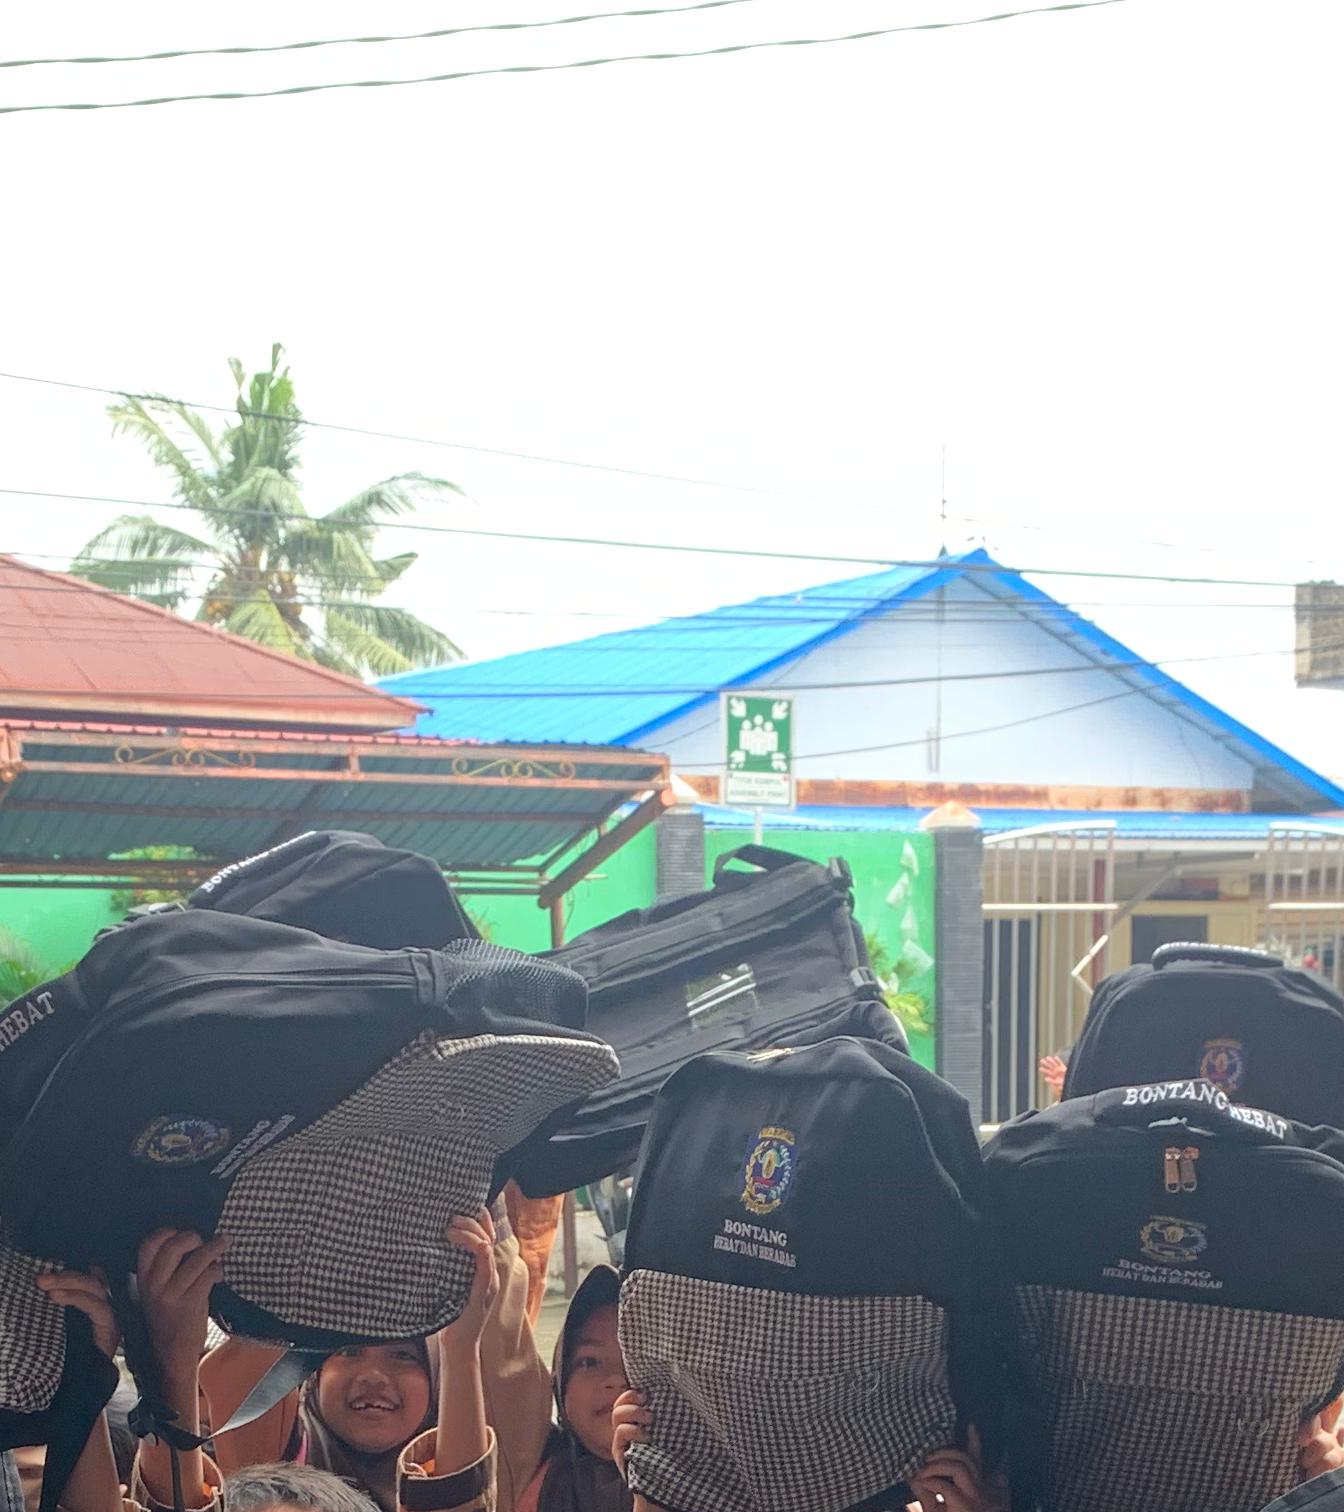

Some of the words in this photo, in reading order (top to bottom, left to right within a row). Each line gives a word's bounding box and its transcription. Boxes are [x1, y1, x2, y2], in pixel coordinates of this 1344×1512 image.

[1123, 1082, 1229, 1110] BONTANG
[1229, 1106, 1287, 1139] HEBAT
[724, 1219, 788, 1247] BONTANG
[1118, 1259, 1212, 1279] BONTANG
